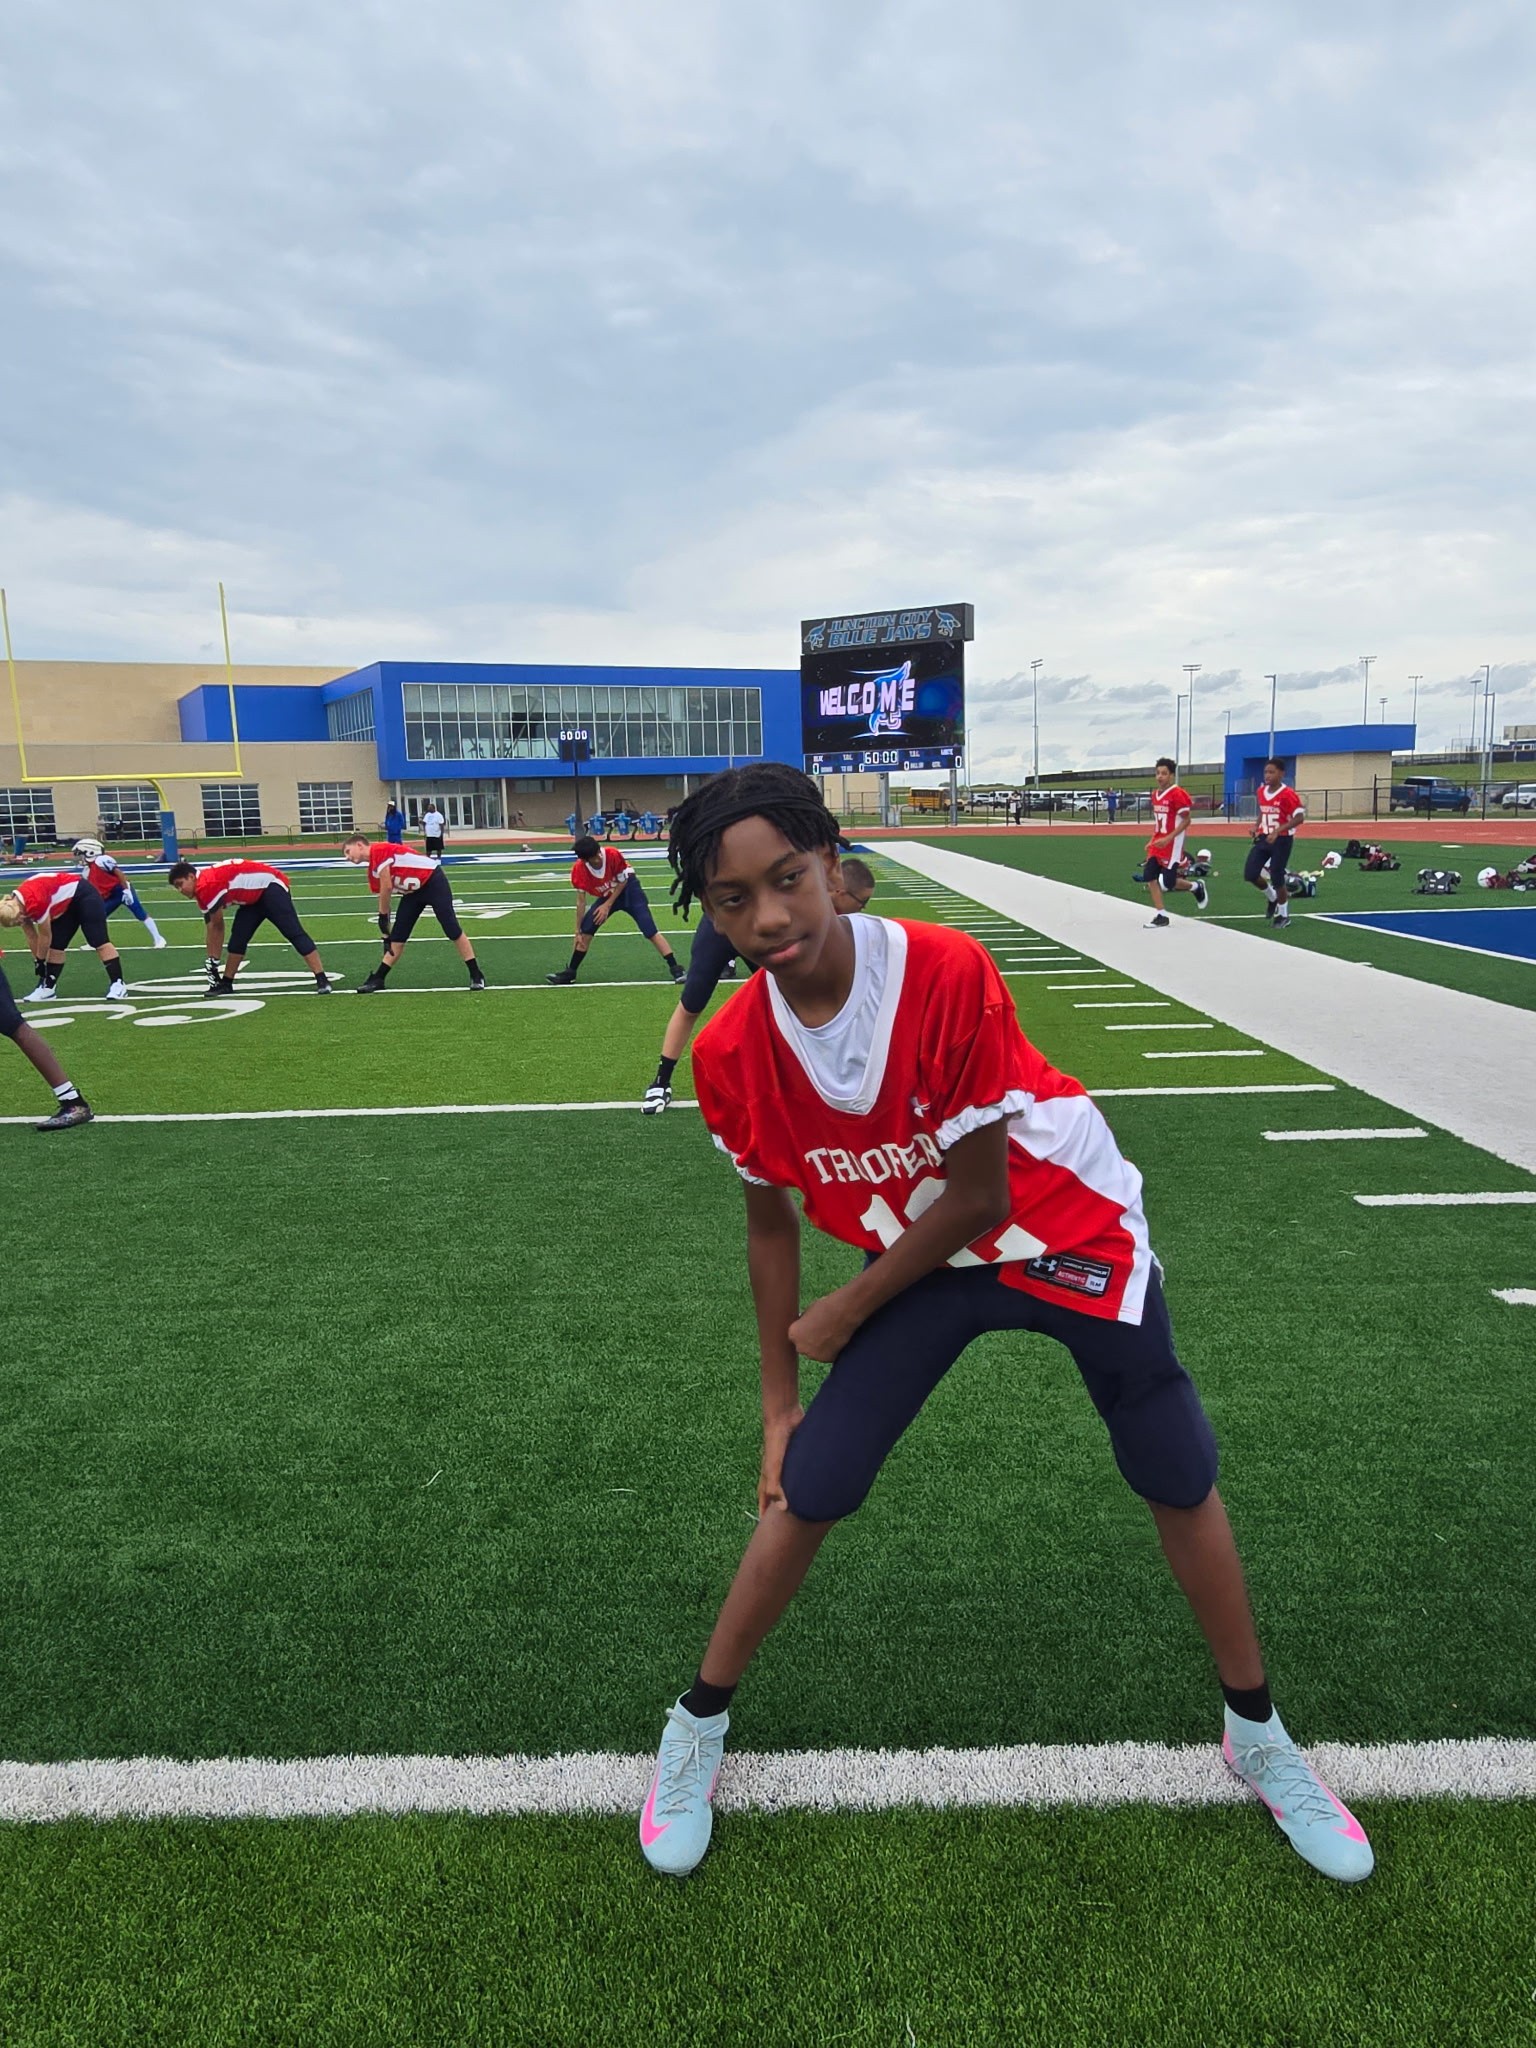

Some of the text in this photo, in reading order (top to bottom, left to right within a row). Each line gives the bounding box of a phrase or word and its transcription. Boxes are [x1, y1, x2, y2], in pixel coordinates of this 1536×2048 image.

[827, 610, 933, 633] JUNCTION CITY
[828, 623, 932, 648] BLUE JAYS
[820, 678, 915, 716] WELCOME
[864, 751, 898, 765] 60:00
[955, 755, 962, 768] 0
